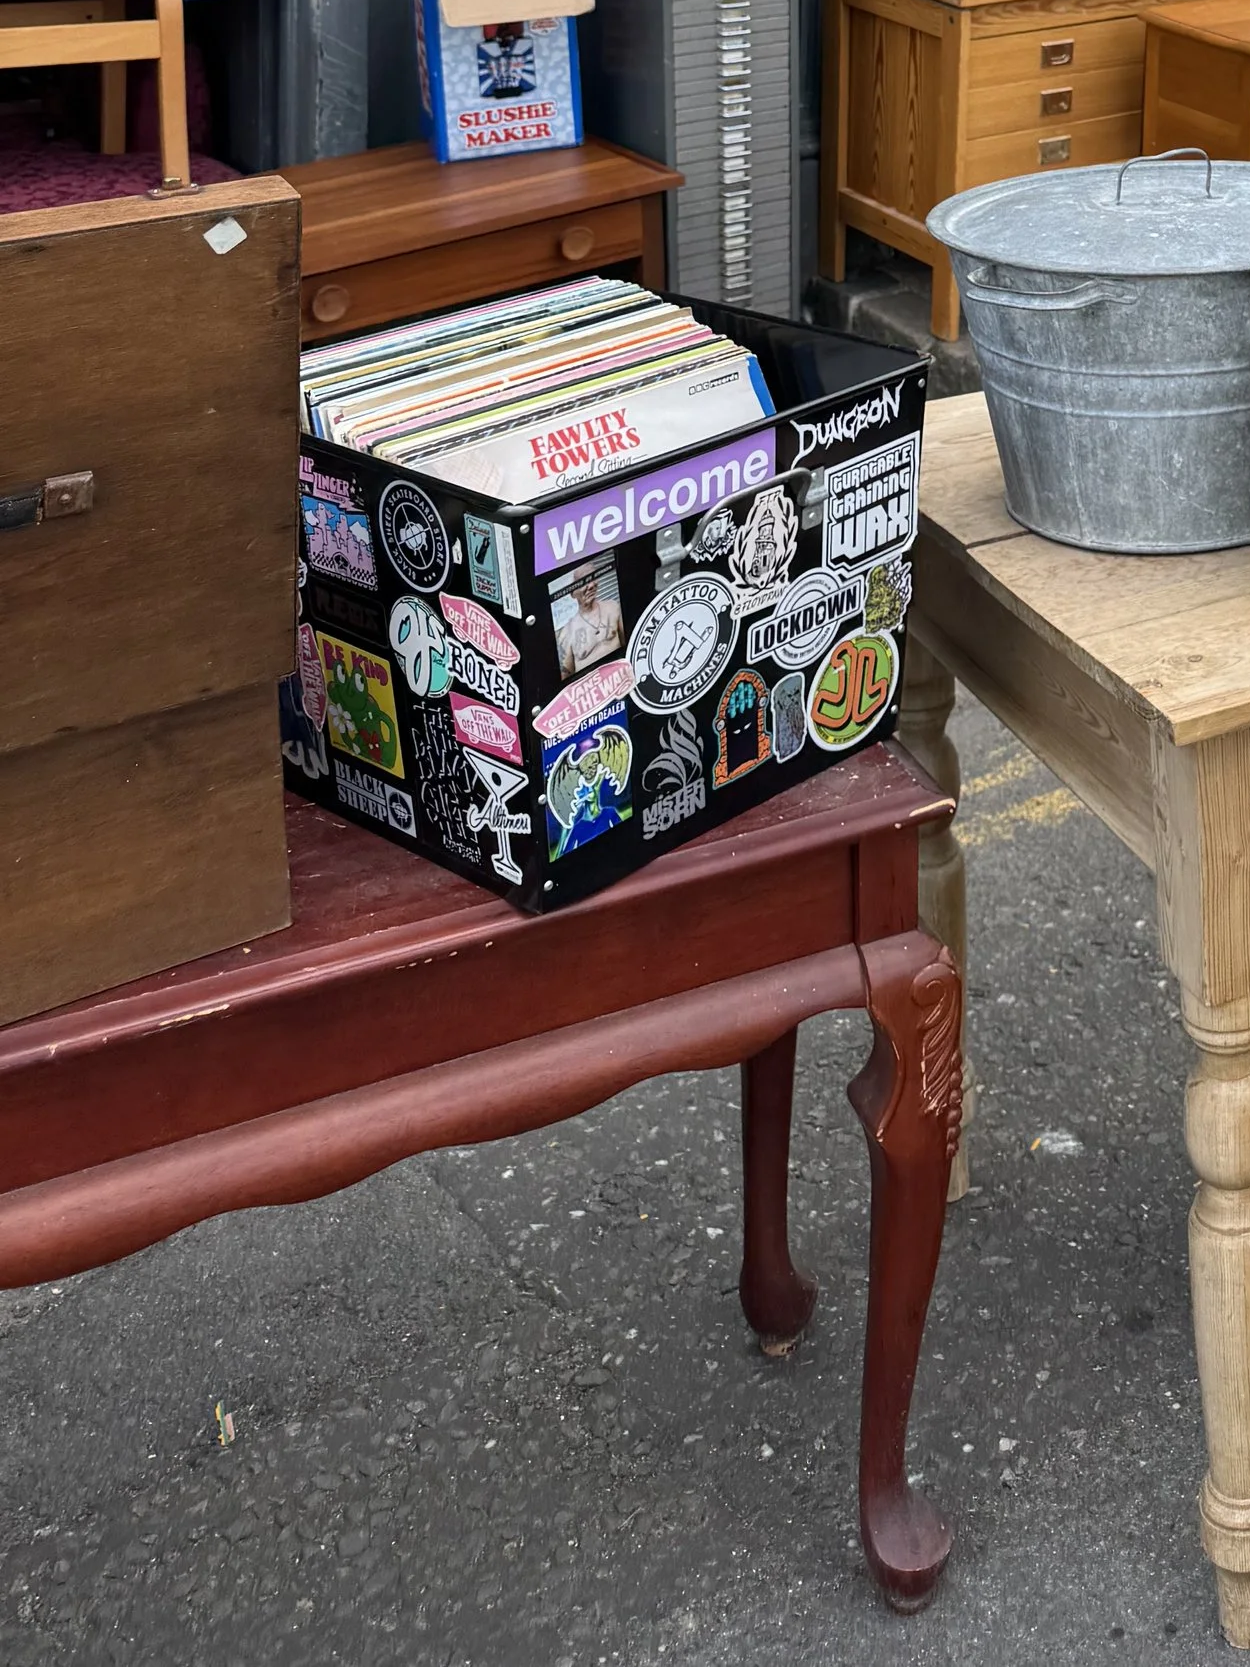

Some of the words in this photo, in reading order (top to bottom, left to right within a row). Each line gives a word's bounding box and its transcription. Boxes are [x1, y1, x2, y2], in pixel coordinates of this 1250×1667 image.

[465, 123, 552, 149] MAKER
[688, 380, 711, 396] BBC
[528, 408, 628, 461] FAWLTY
[790, 379, 906, 470] DUNGEON
[531, 428, 641, 480] TOWERS
[546, 448, 770, 561] welcome
[387, 488, 436, 524] SKATEBOARD
[432, 527, 446, 568] STORE
[829, 491, 913, 559] WAX
[463, 601, 493, 631] VANS
[660, 586, 720, 618] TATTOO
[752, 587, 861, 654] LOCKDOWN
[467, 619, 488, 646] THE
[635, 610, 662, 662] DSM
[322, 638, 345, 668] BE
[658, 642, 728, 704] MACHINES
[448, 643, 519, 712] BONES
[565, 671, 602, 702] VANS
[470, 708, 496, 727] VANS
[573, 686, 600, 719] THE
[598, 699, 627, 725] DEALER
[476, 722, 495, 740] THE
[334, 758, 385, 798] BLACK
[337, 783, 388, 823] SHEEP
